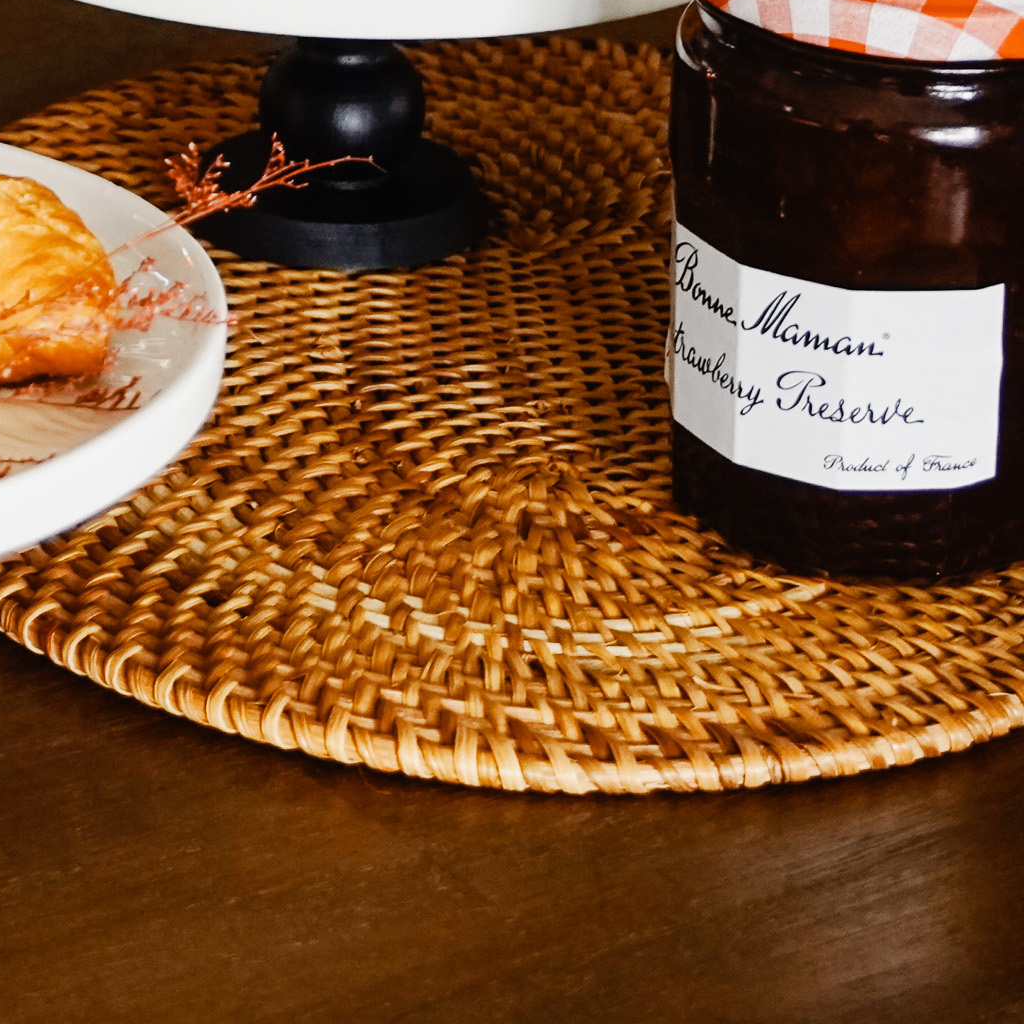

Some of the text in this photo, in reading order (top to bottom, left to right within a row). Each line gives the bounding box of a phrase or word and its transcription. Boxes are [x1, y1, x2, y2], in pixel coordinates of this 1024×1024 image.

[675, 241, 737, 326] Bonne
[673, 321, 925, 424] trawberry Preserve
[823, 453, 977, 480] Product of France
